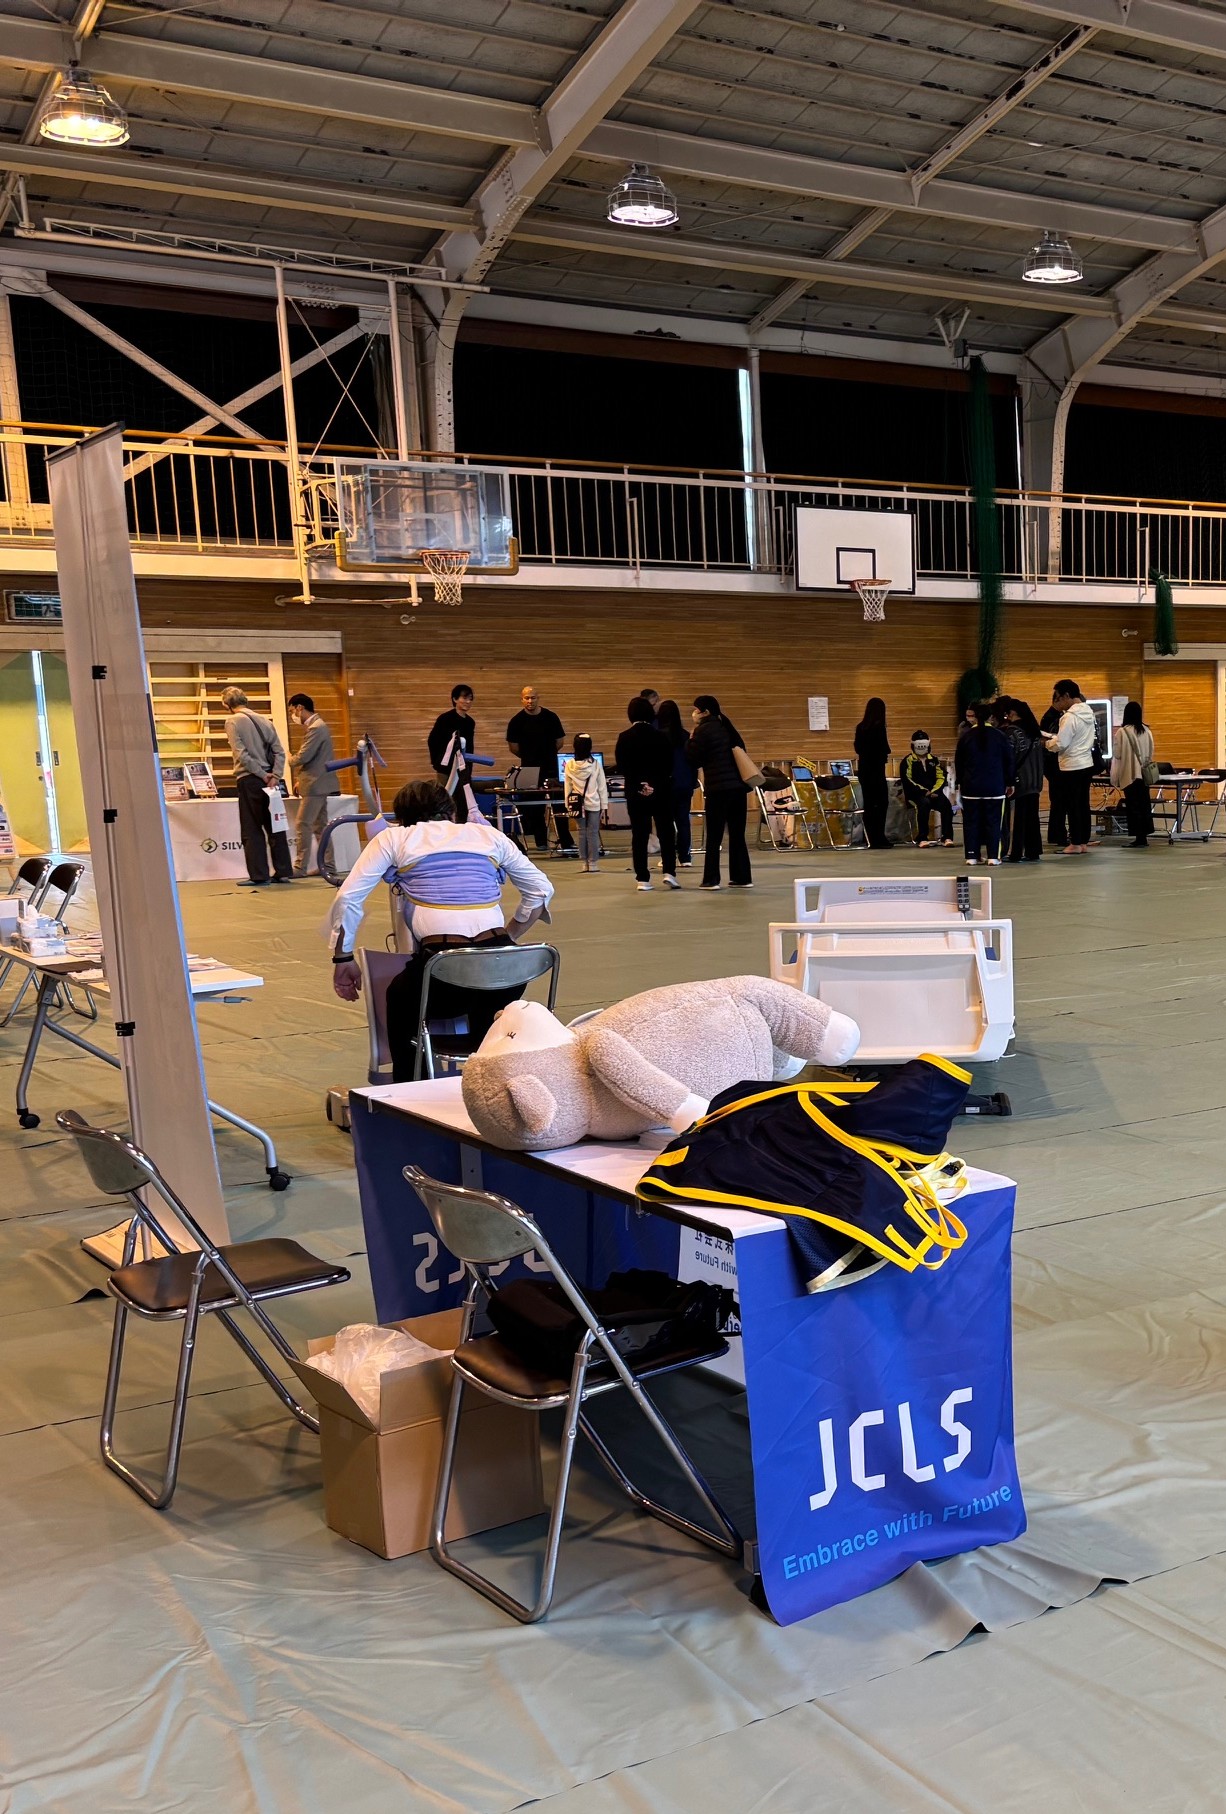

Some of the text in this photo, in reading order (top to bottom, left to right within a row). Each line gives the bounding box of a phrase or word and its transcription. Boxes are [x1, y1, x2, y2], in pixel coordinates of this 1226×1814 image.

[221, 841, 244, 851] SILV
[809, 1386, 973, 1512] JCLS
[782, 1485, 1013, 1580] Embrace with Future
